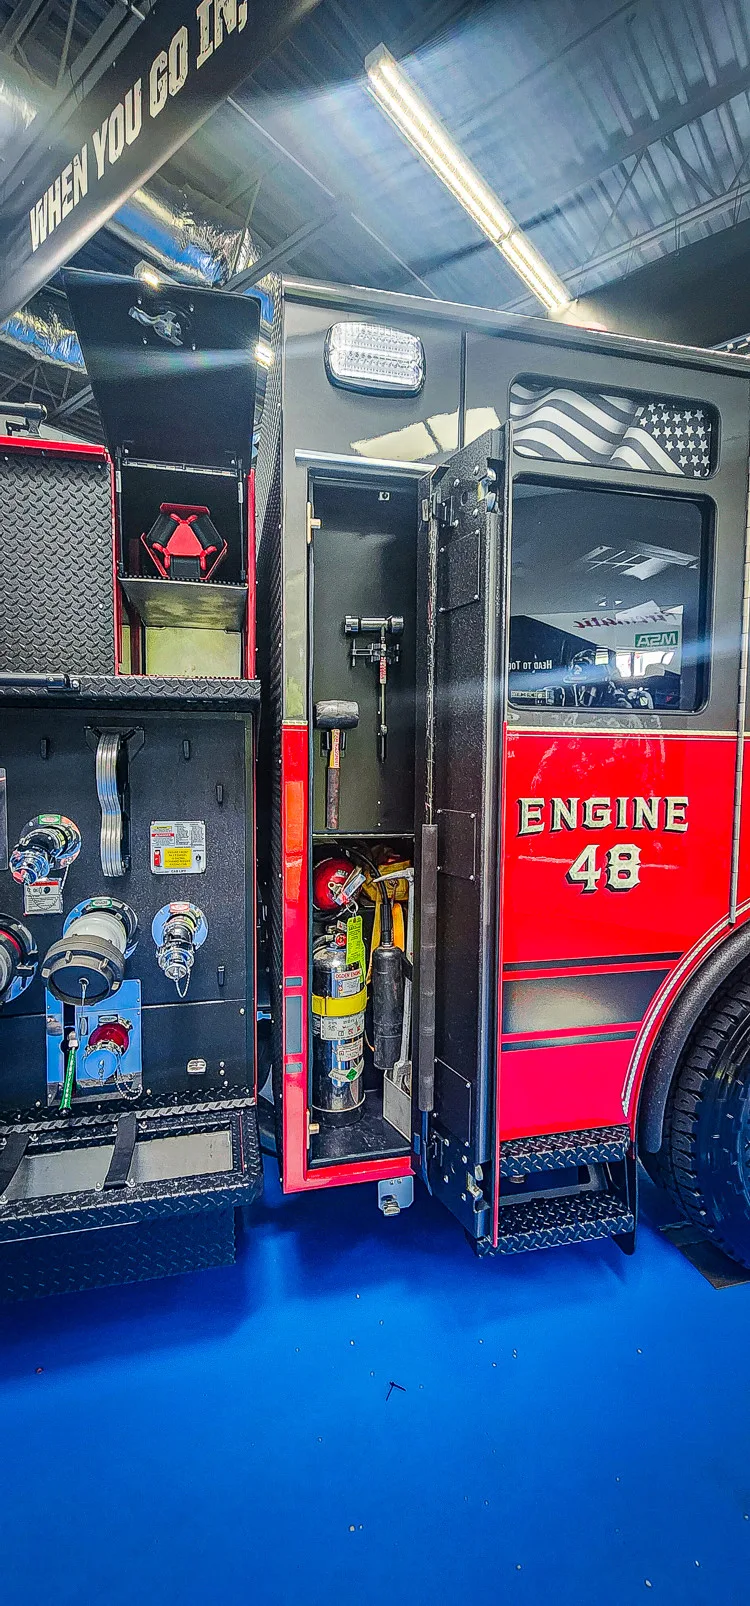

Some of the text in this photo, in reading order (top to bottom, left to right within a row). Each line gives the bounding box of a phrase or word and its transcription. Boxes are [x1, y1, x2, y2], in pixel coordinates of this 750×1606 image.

[30, 143, 88, 253] WHEN
[92, 77, 142, 181] YOU
[149, 25, 189, 119] GO
[516, 796, 690, 837] ENGINE
[565, 843, 642, 894] 48
